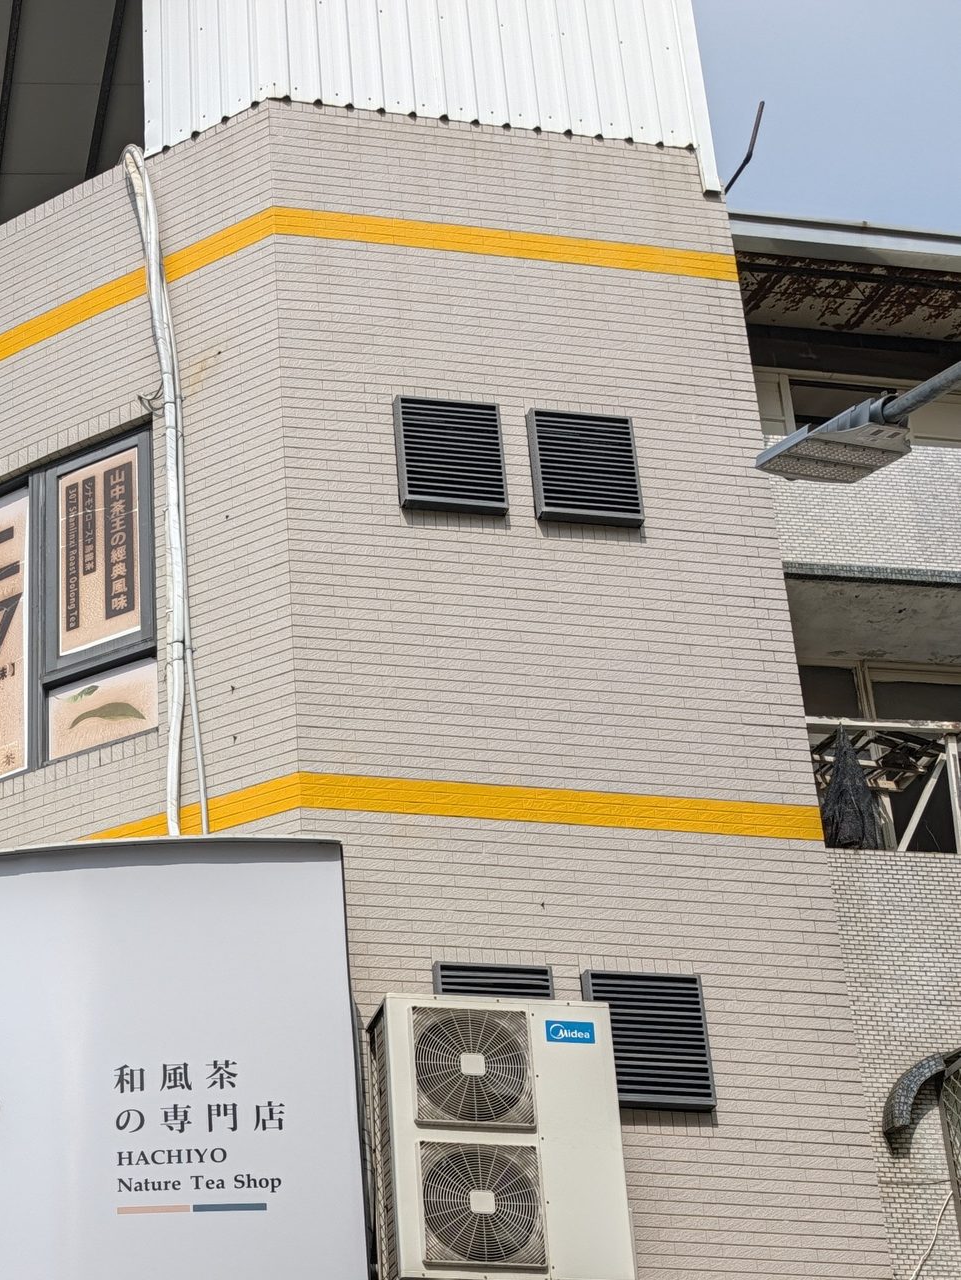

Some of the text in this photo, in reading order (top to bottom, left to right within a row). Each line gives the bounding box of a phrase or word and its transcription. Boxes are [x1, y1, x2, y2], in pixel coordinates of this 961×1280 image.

[109, 469, 128, 611] 山中茶王の經典風味
[69, 550, 79, 577] Roast
[69, 577, 79, 611] Oolong
[553, 1026, 590, 1039] Midea
[114, 1060, 238, 1093] 和風茶
[115, 1101, 285, 1134] の専門店
[117, 1147, 228, 1166] HACHIYO
[117, 1173, 282, 1193] Nature Tea Shop
